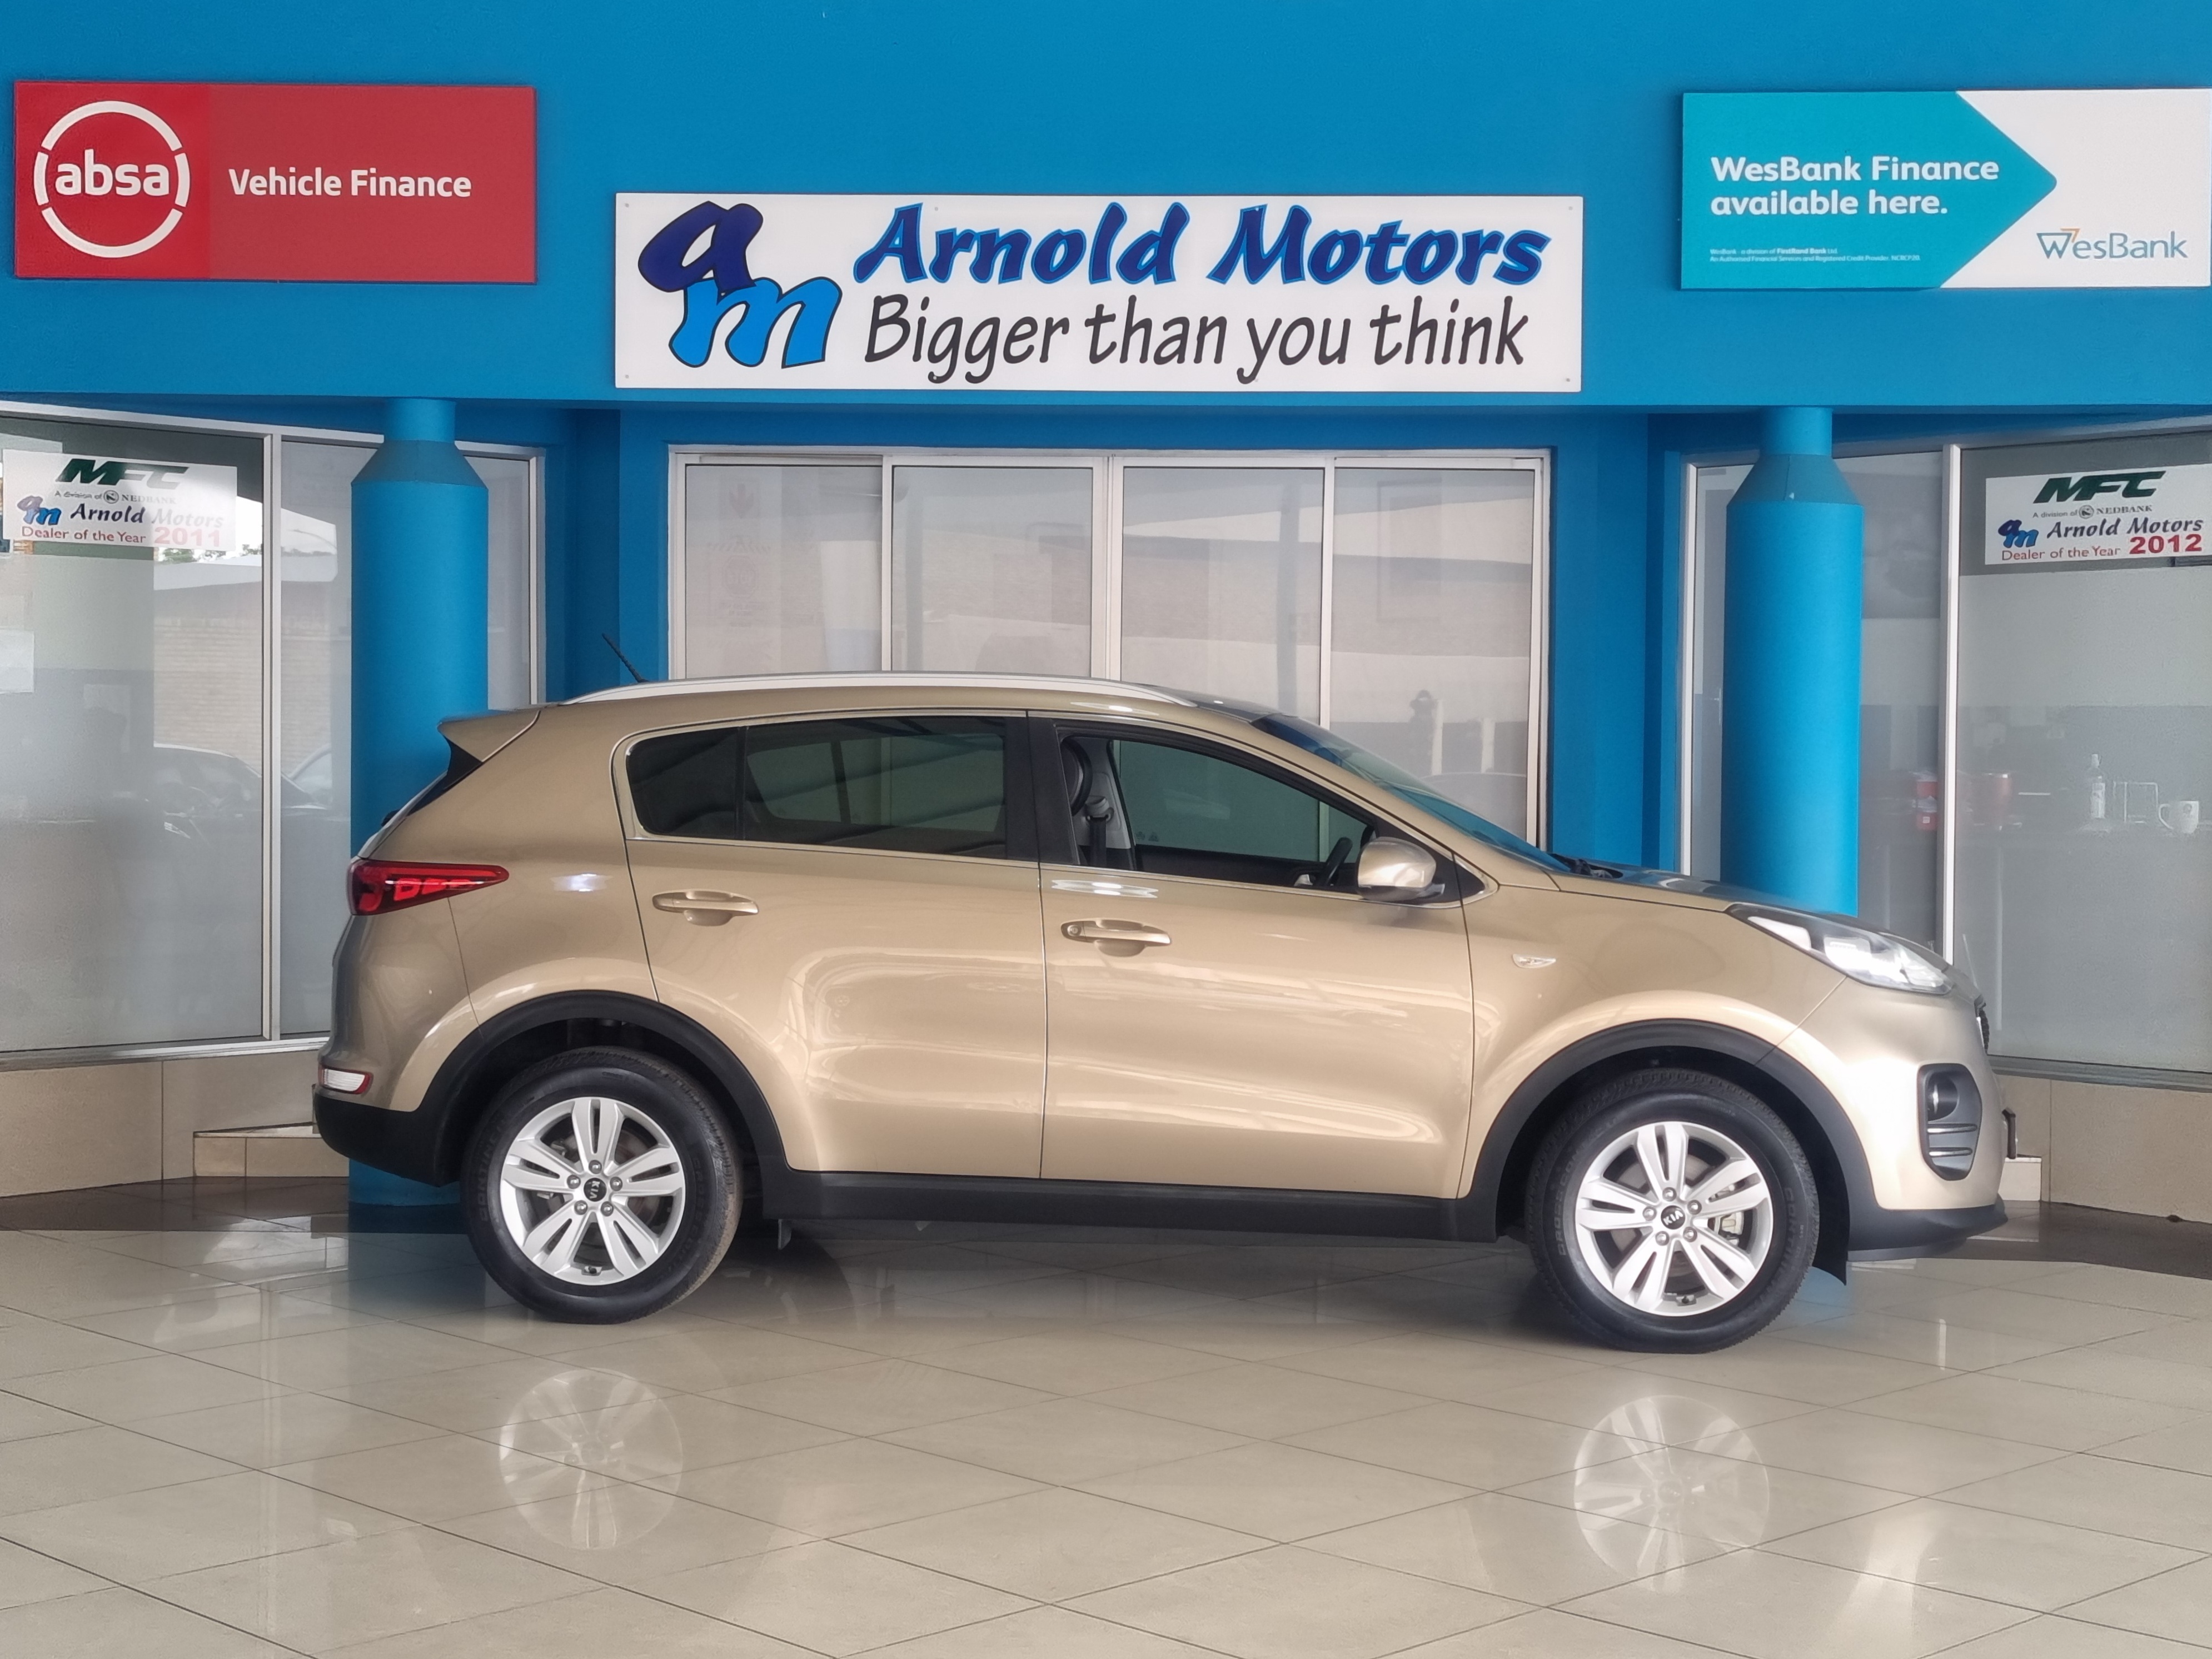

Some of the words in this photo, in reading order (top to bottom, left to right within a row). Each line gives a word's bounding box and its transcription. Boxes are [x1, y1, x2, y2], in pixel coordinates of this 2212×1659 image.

[55, 149, 170, 196] absa
[1711, 156, 1861, 182] WesBank
[1873, 156, 1999, 181] Finance
[228, 167, 342, 197] Vehicle
[351, 167, 472, 198] Finance
[1711, 190, 1859, 215] available
[1869, 190, 1948, 215] here.
[853, 202, 1190, 285] Arnold
[1206, 203, 1552, 286] Motors
[2037, 228, 2188, 260] WesBank
[865, 293, 1069, 384] Bigger
[1085, 295, 1227, 365] than
[1237, 317, 1351, 385] you
[1369, 295, 1529, 366] think
[55, 459, 190, 490] MFC
[2032, 471, 2166, 504] MFC
[121, 494, 177, 505] NEDBANK
[2096, 505, 2153, 515] NEDBANK
[70, 503, 146, 524] Arnold
[152, 507, 225, 527] Motors
[2046, 518, 2122, 539] Arnold
[2126, 517, 2204, 534] Motors
[22, 526, 69, 540] Dealer
[74, 527, 89, 540] of
[93, 529, 114, 541] the
[117, 531, 146, 544] Year
[154, 527, 221, 547] 2011
[2002, 549, 2045, 561] Dealer
[2050, 547, 2063, 558] of
[2068, 547, 2089, 557] the
[2091, 546, 2121, 556] Year
[2129, 534, 2203, 555] 2012
[590, 1180, 600, 1199] KIA
[1663, 1210, 1683, 1225] KIA
